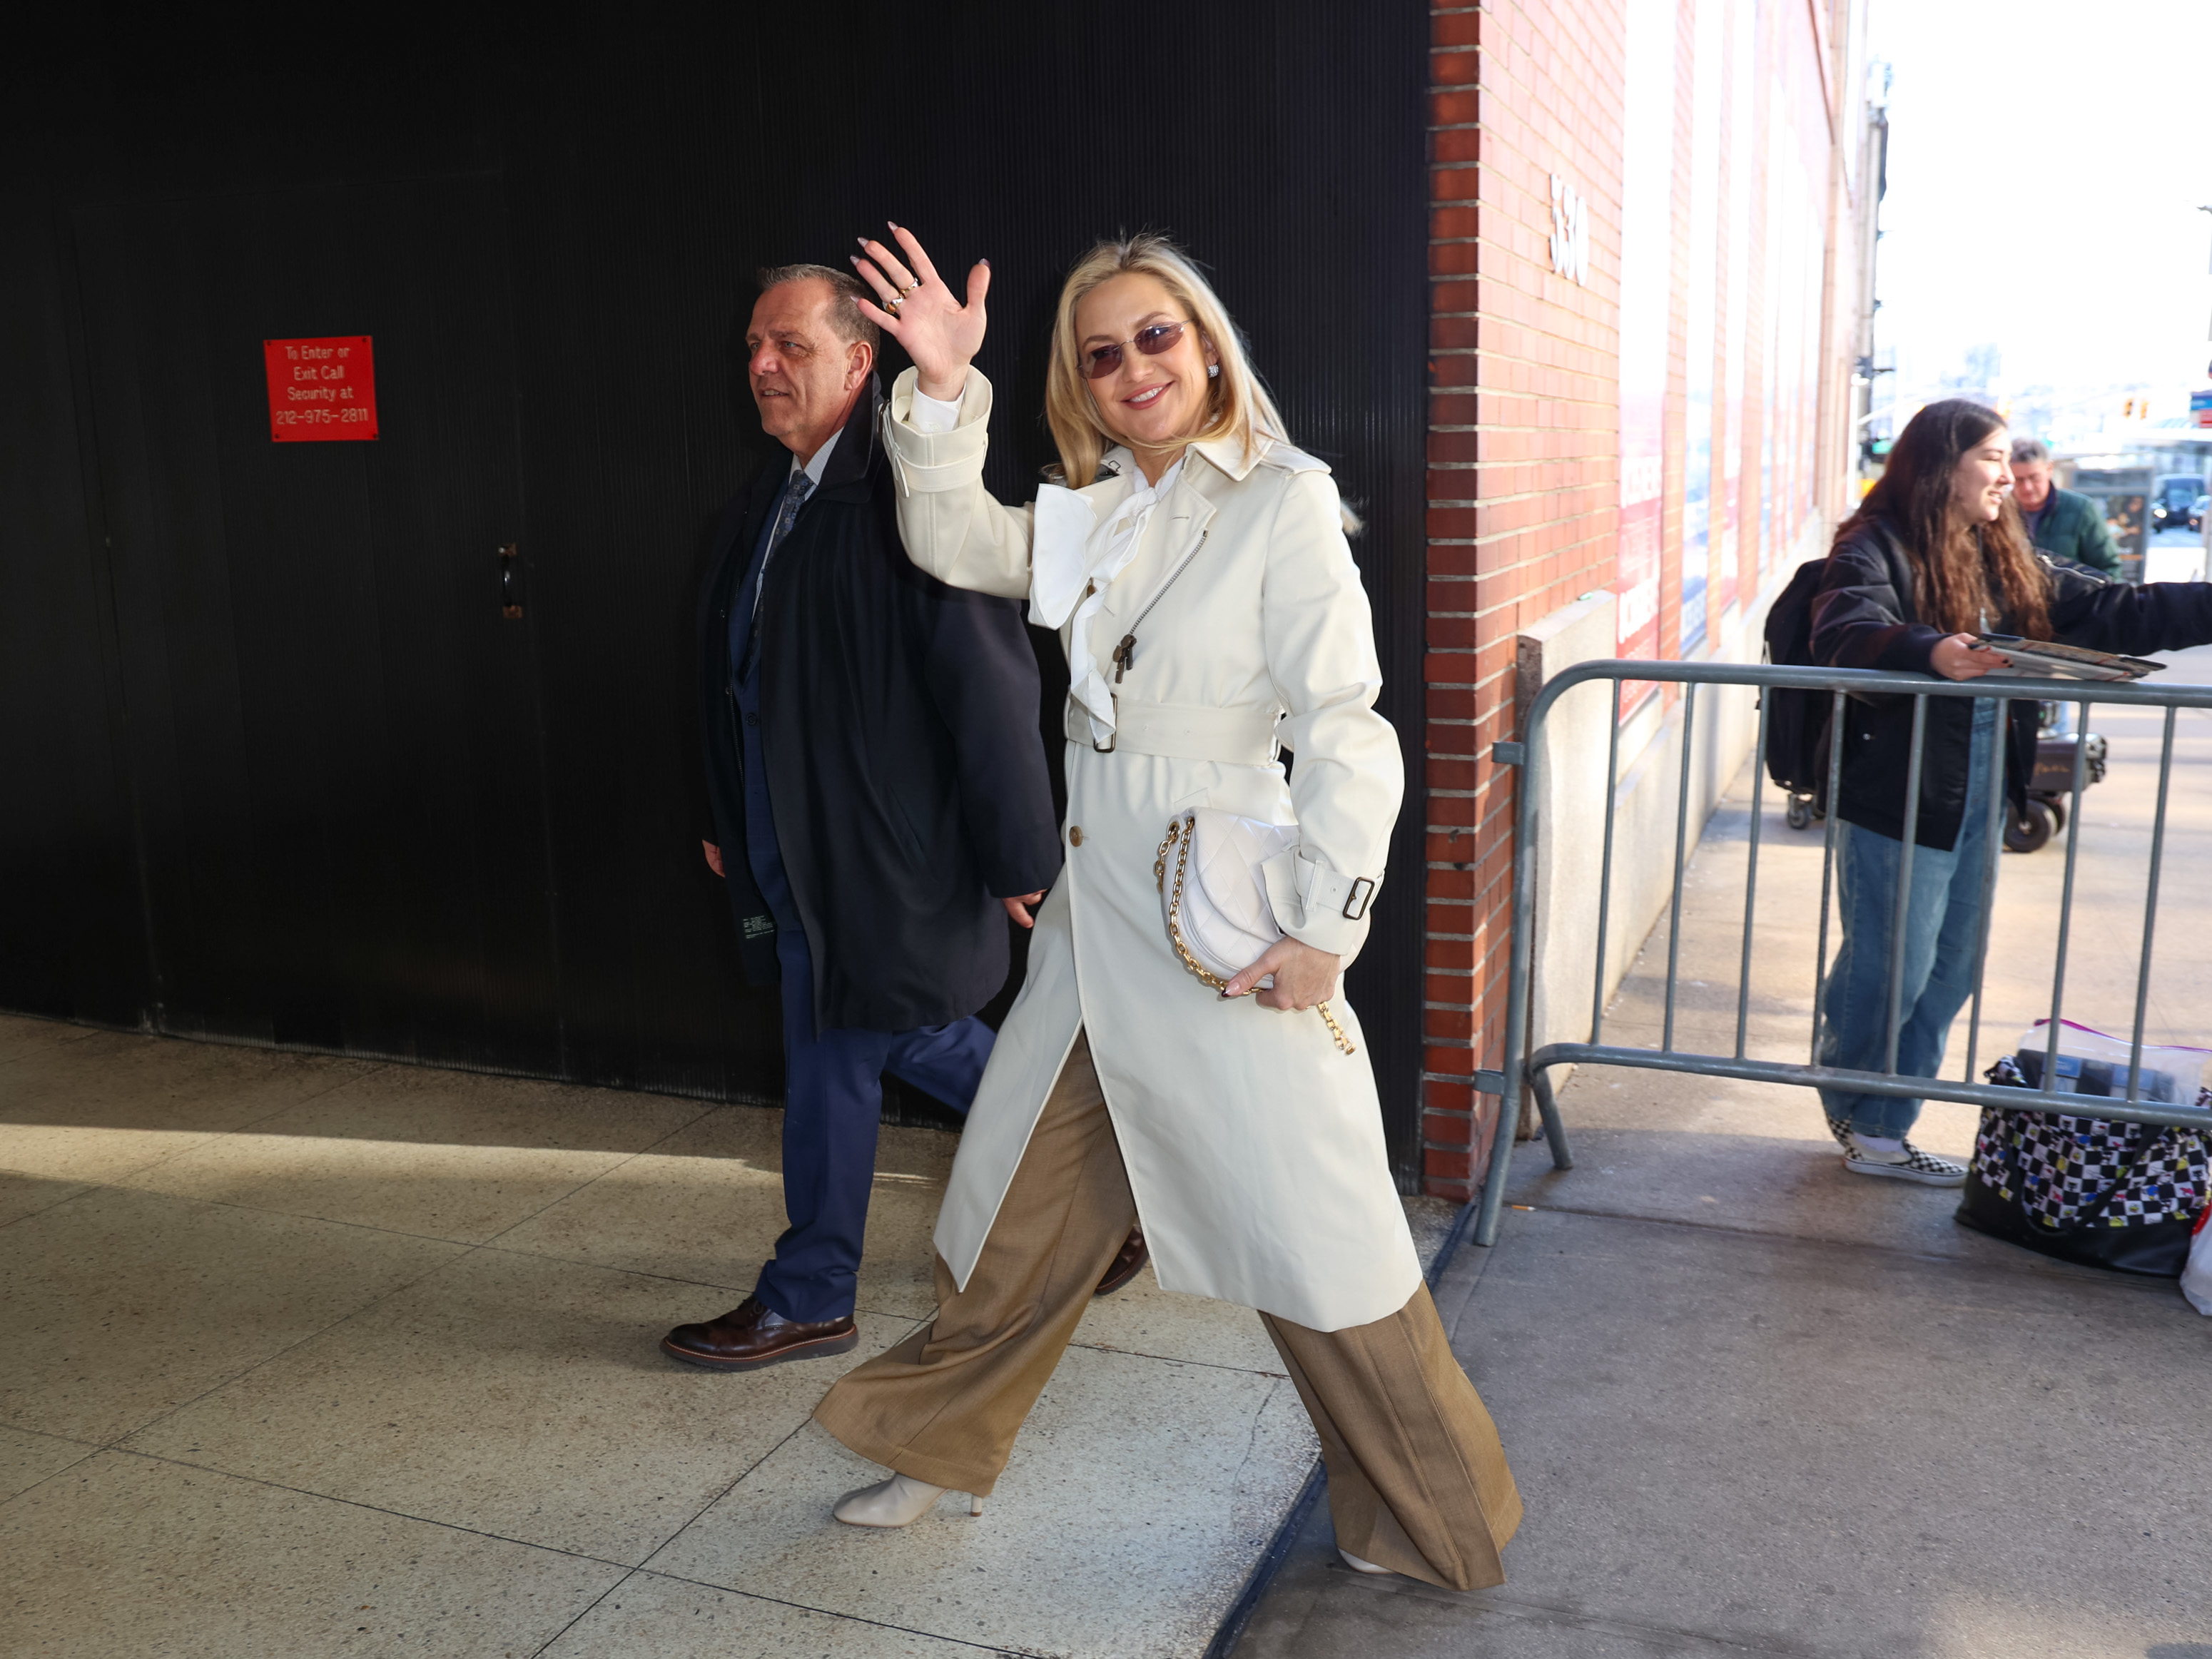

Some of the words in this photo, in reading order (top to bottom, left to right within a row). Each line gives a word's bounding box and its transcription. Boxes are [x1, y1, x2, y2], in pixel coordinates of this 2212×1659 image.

[1550, 173, 1589, 285] 530
[285, 346, 298, 360] To
[301, 345, 333, 360] Enter
[338, 347, 350, 358] or
[293, 366, 318, 381] Exit
[321, 365, 345, 380] Call
[287, 386, 336, 402] Security
[340, 385, 354, 399] at
[275, 407, 369, 425] 212-975-2811
